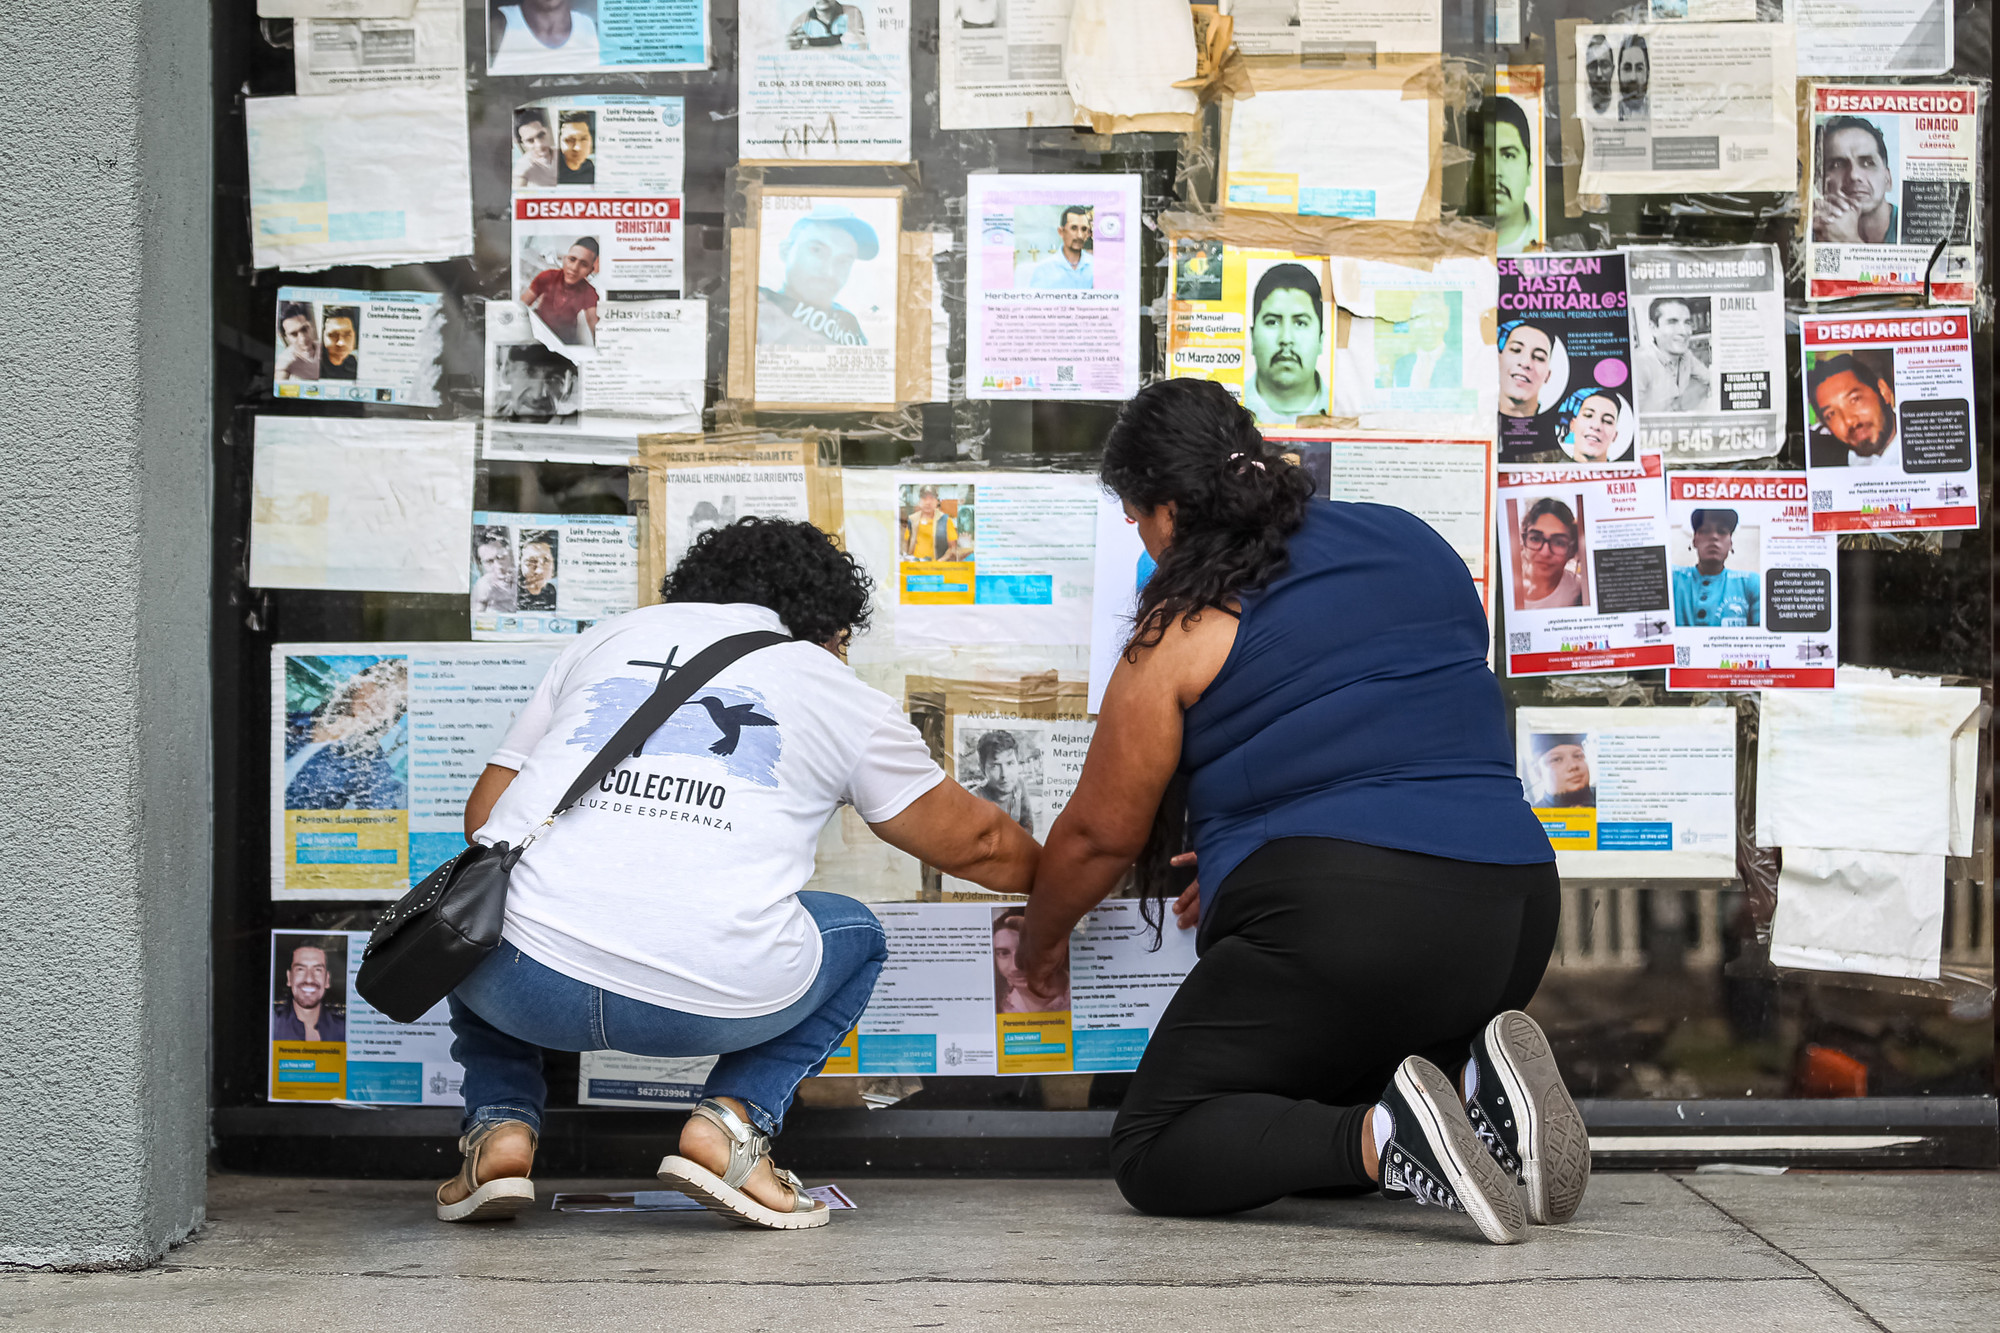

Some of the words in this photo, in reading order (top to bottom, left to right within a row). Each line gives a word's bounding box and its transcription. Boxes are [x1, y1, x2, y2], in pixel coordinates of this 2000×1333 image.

[1826, 95, 1963, 112] DESAPARECIDO
[1915, 118, 1958, 132] IGNACIO
[526, 202, 670, 218] DESAPARECIDO
[774, 197, 812, 211] BUSCA
[615, 221, 671, 234] CRHISTIAN
[1498, 260, 1518, 276] SE
[1523, 258, 1601, 275] BUSCAN
[1632, 263, 1670, 280] JOVEN
[1677, 260, 1766, 279] DESAPARECIDO
[1518, 276, 1581, 292] HASTA
[985, 292, 1032, 300] Heriberto
[1034, 292, 1078, 300] Armenta
[1081, 292, 1119, 300] Zamora
[1498, 291, 1626, 310] CONTRARL@S
[1720, 297, 1757, 311] DANIEL
[1176, 324, 1204, 332] Chávez
[1206, 325, 1241, 333] Gutiérrez
[1817, 320, 1957, 340] DESAPARECIDO
[1896, 346, 1930, 355] JONATHAN
[1931, 344, 1968, 353] ALEJANDRO
[1175, 352, 1186, 362] 01
[1188, 352, 1215, 363] Marzo
[1217, 353, 1240, 363] 2009
[1724, 382, 1732, 392] SU
[1759, 381, 1767, 390] EN
[1678, 428, 1713, 452] 545
[1718, 426, 1766, 450] 2630
[660, 473, 701, 484] NATANAEL
[703, 472, 752, 483] HERNÁNDEZ
[753, 472, 804, 482] BARRIENTOS
[1607, 482, 1637, 495] KENIA
[1031, 712, 1083, 722] REGRESAR
[599, 767, 726, 810] COLECTIVO
[1052, 801, 1062, 809] de
[579, 797, 608, 810] LUZ
[614, 802, 632, 814] DE
[638, 806, 733, 832] ESPERANZA
[637, 1088, 690, 1098] 5627339904
